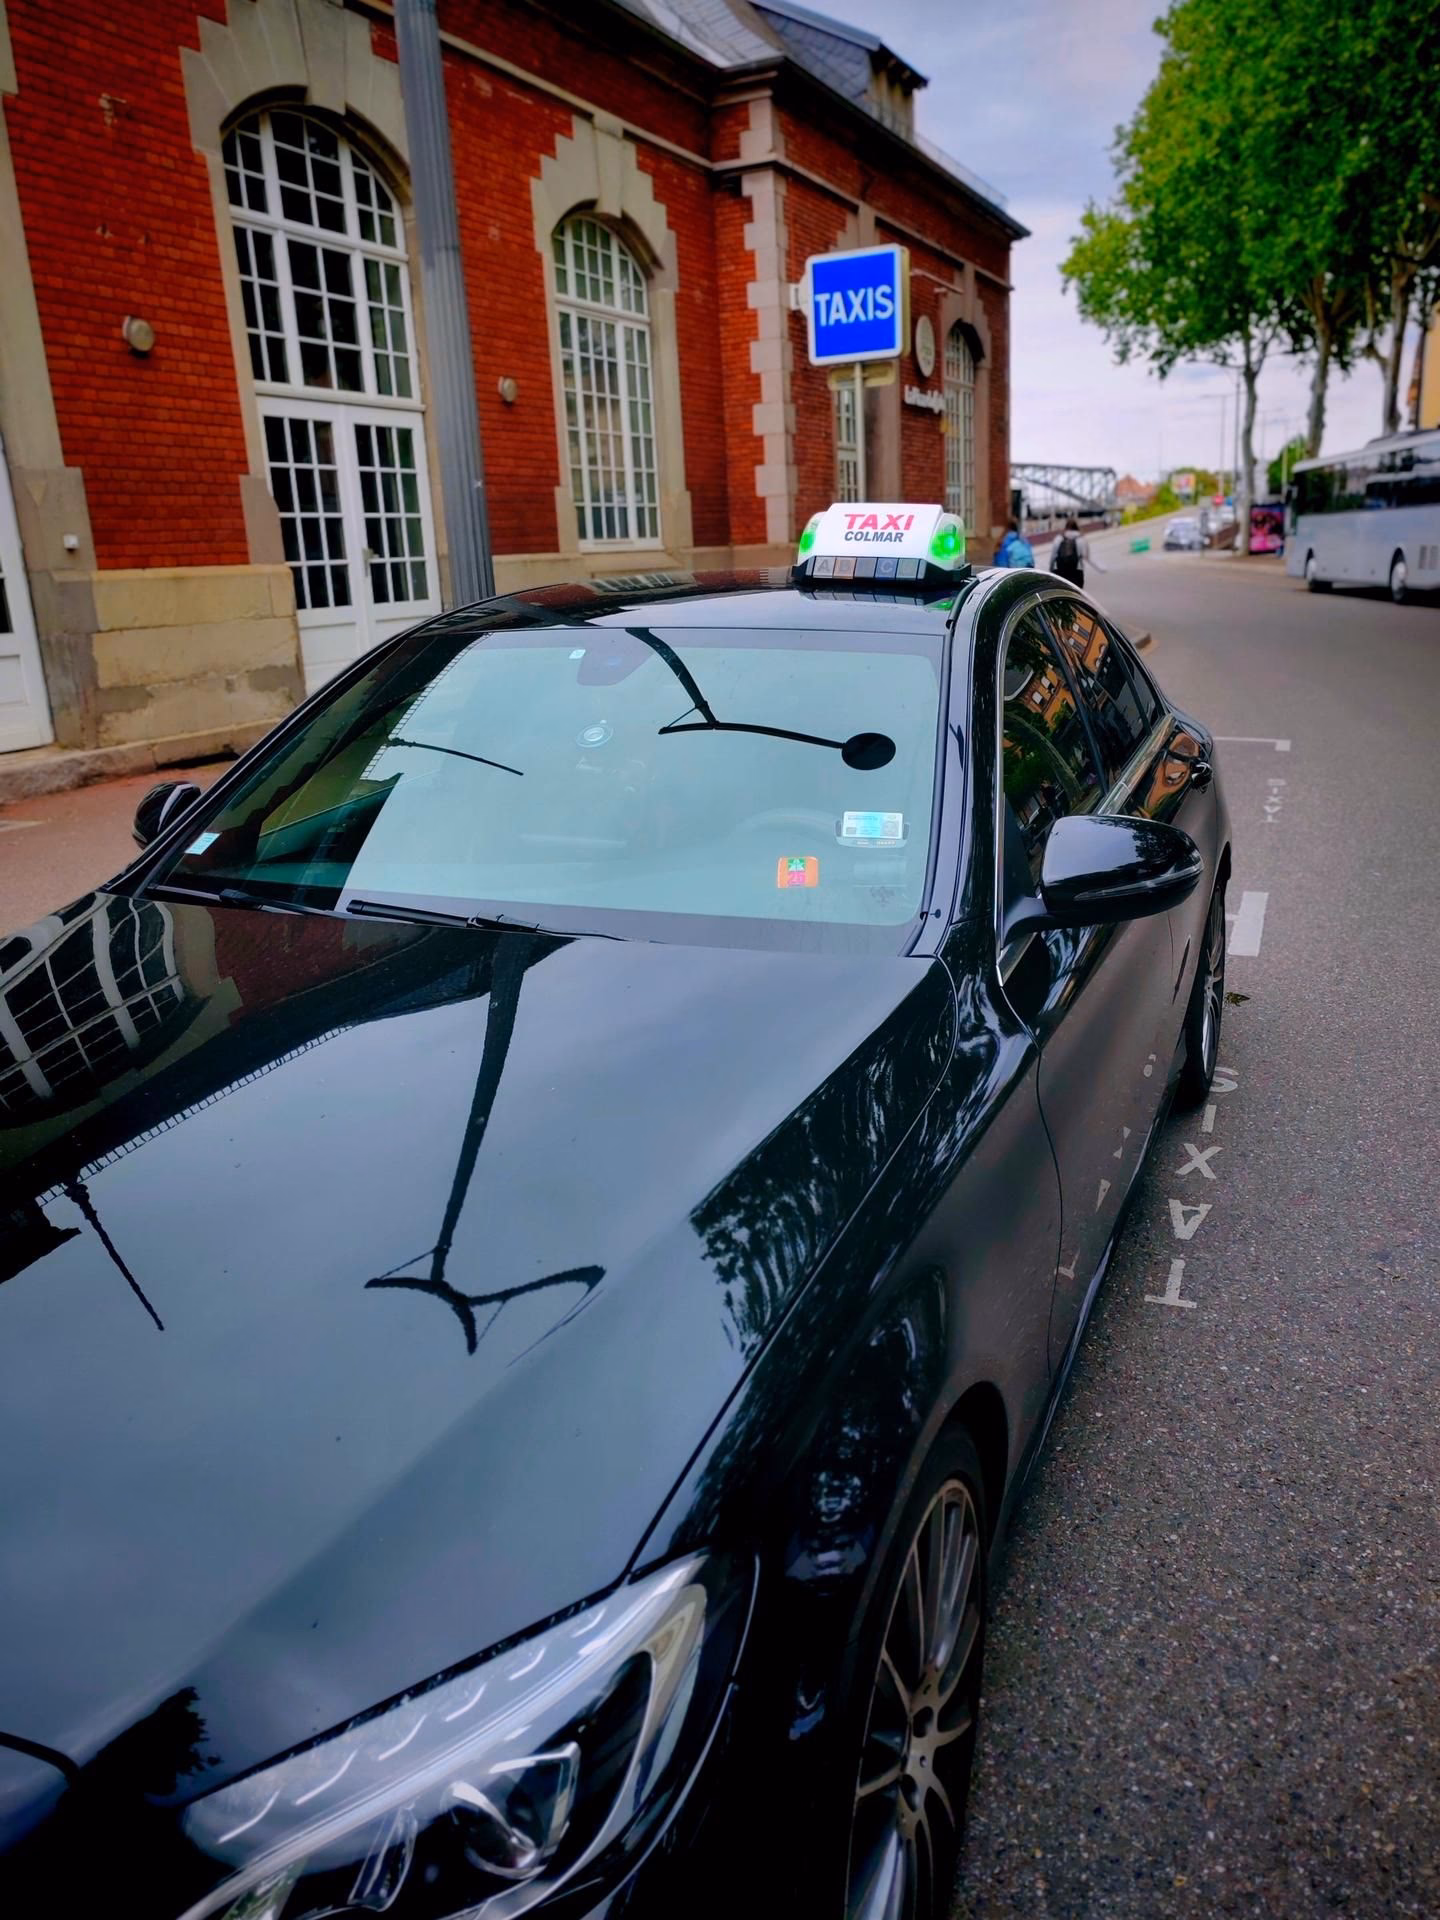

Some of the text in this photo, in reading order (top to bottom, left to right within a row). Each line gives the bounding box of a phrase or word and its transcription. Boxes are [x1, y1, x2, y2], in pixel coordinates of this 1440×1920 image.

[814, 284, 895, 327] TAXIS
[844, 514, 915, 531] TAXI
[844, 531, 904, 543] COLMAR
[1143, 1066, 1240, 1309] TAXIS
